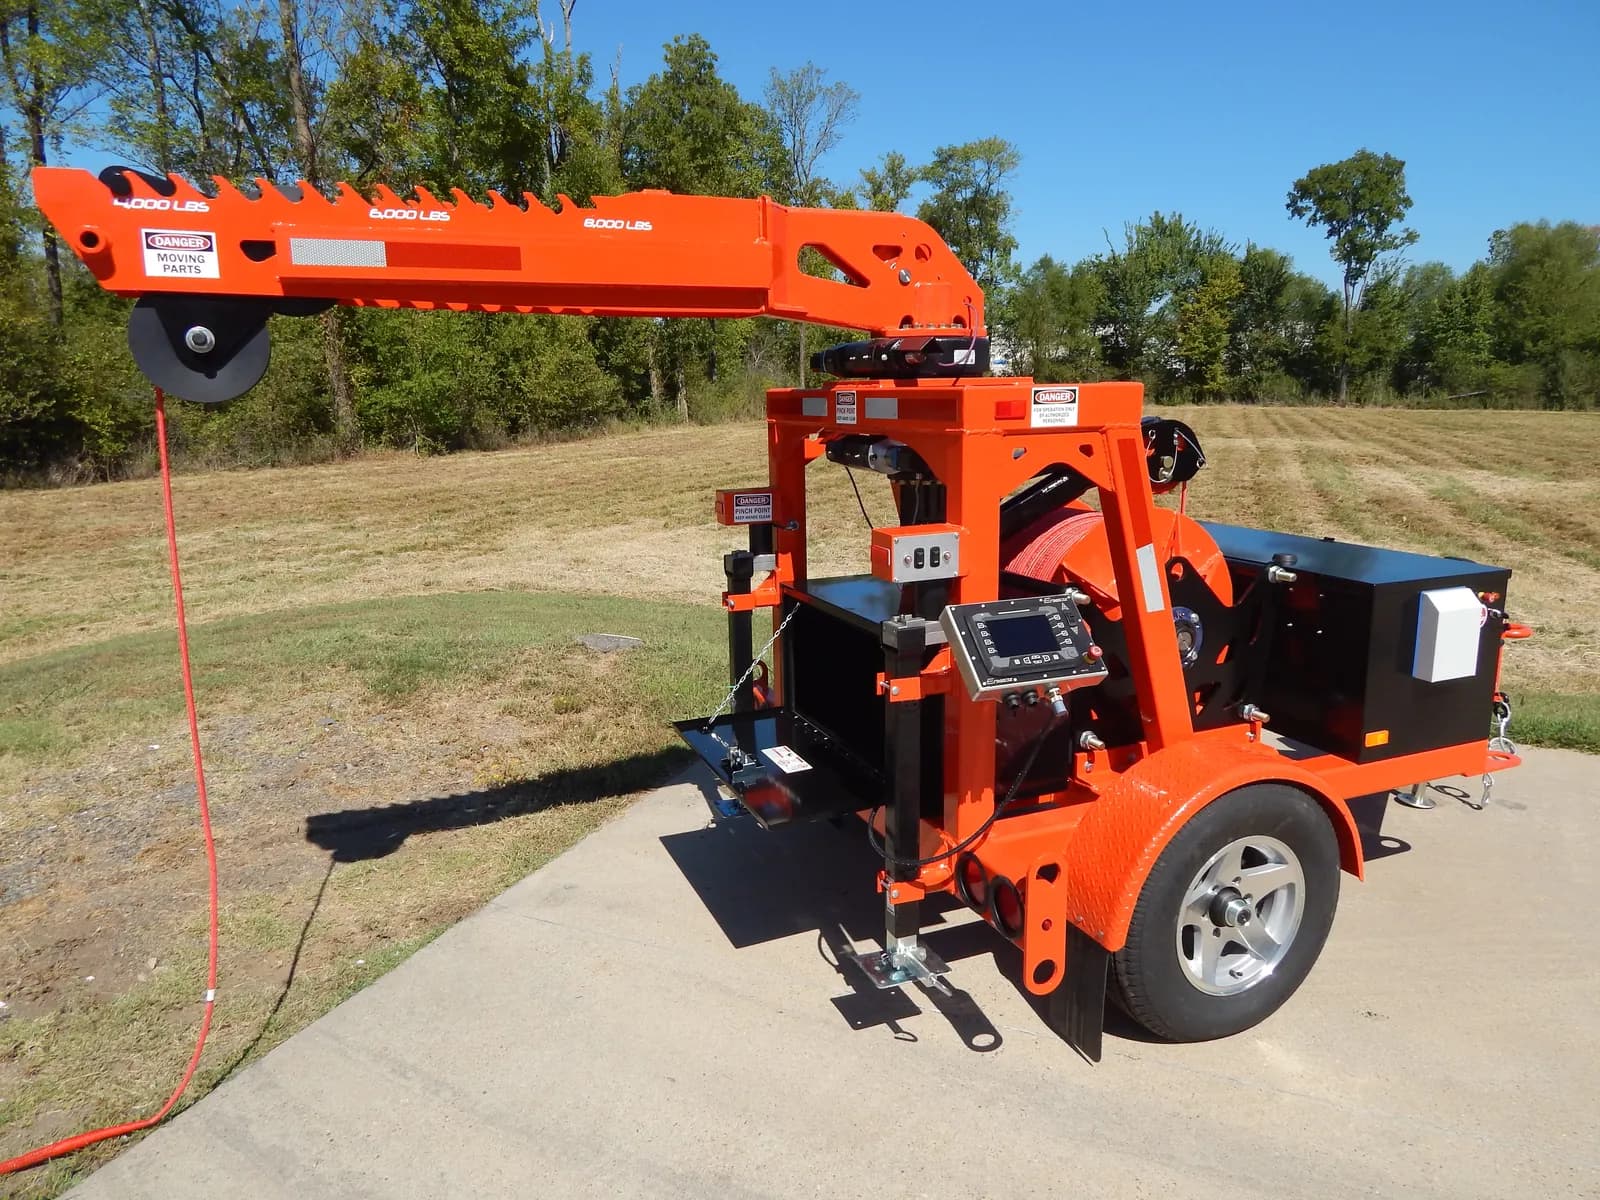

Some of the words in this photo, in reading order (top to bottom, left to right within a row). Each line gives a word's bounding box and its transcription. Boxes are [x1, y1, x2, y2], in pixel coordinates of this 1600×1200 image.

[173, 200, 210, 212] LBS
[369, 208, 417, 220] 6,000
[419, 210, 450, 221] LBS
[626, 220, 653, 231] LBS
[155, 236, 204, 248] DANGER
[157, 253, 205, 264] MOVING
[163, 264, 201, 274] PARTS
[1040, 392, 1070, 401] DANGER
